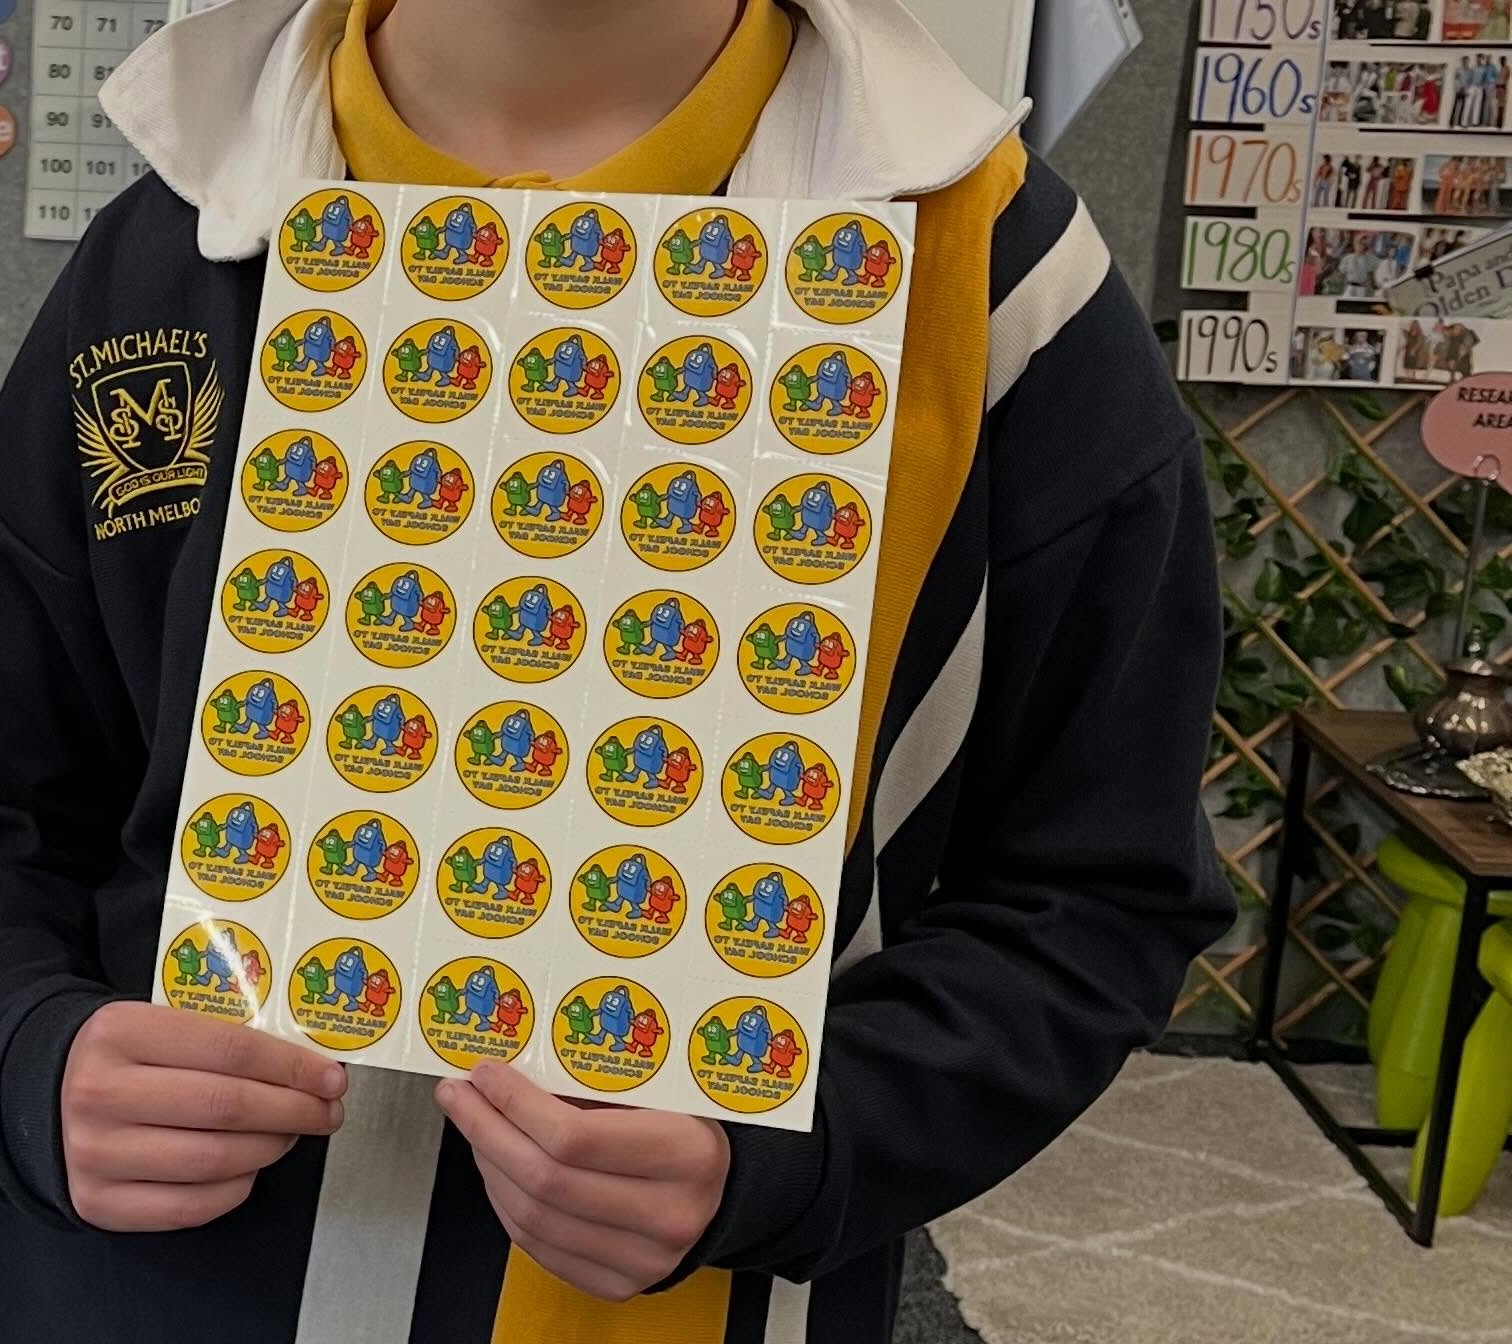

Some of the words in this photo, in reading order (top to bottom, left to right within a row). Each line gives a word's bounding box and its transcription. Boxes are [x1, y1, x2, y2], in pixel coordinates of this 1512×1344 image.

[50, 16, 73, 31] 70
[48, 63, 71, 79] 80
[1197, 52, 1316, 123] 1960s
[46, 111, 69, 127] 90
[40, 158, 72, 174] 100
[86, 159, 115, 176] 101
[1191, 134, 1302, 205] 1970s
[39, 205, 70, 221] 110
[1187, 220, 1294, 285] 1980s
[1426, 264, 1481, 293] Papa
[90, 328, 208, 371] MICHAEL'S
[1184, 314, 1279, 380] 1990s
[1457, 387, 1512, 404] RESEA
[94, 511, 148, 542] NORTH
